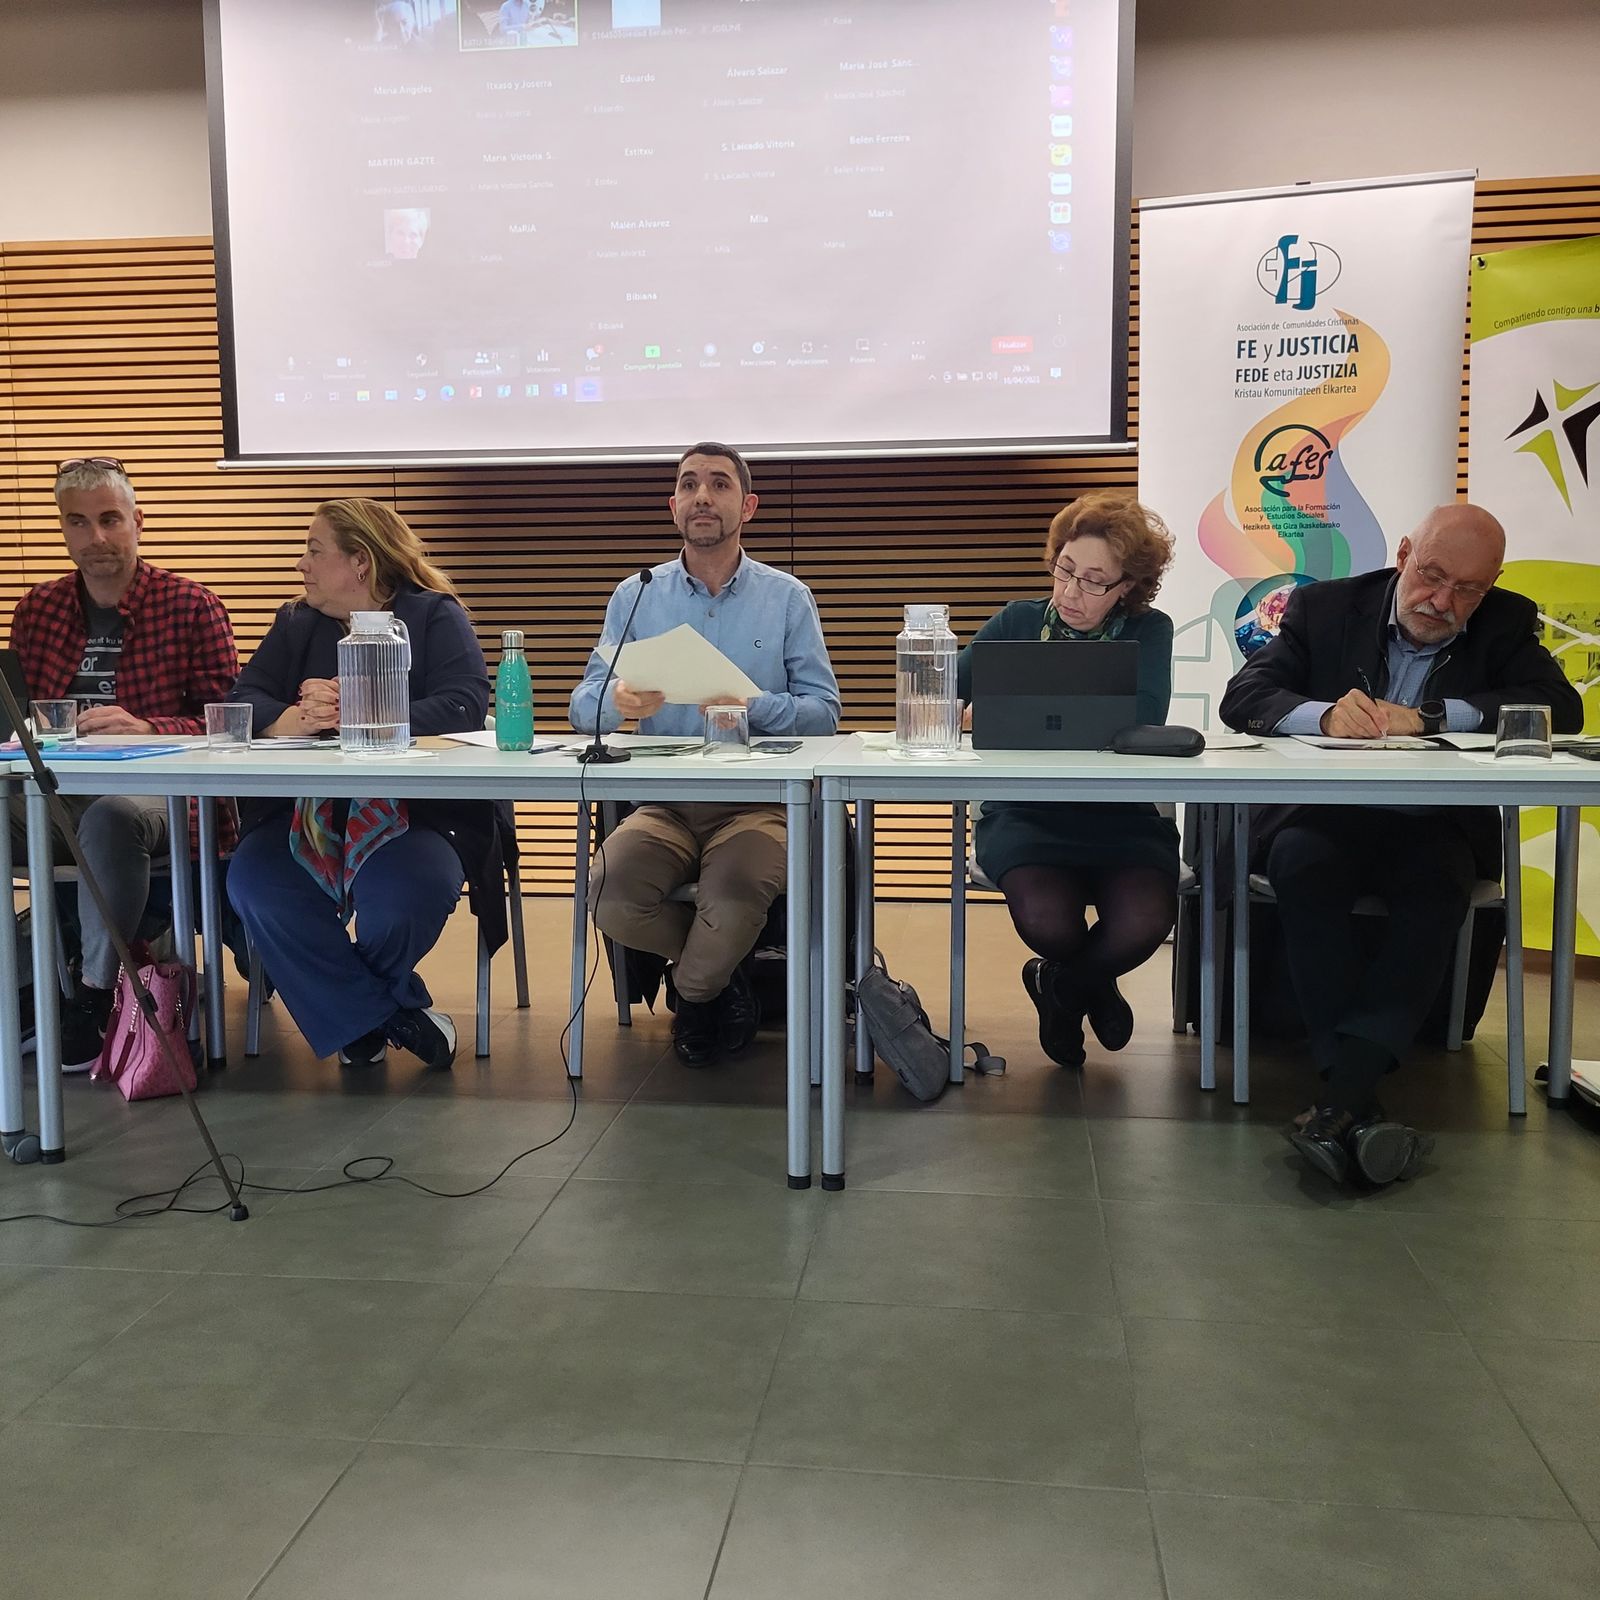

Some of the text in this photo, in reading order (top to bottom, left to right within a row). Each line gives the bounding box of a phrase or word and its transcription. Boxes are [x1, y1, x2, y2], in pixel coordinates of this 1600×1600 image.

[520, 79, 553, 89] Joserra
[619, 73, 656, 84] Eduardo
[766, 138, 796, 149] Vitoria
[875, 134, 911, 144] Ferreira
[1494, 308, 1546, 330] Compartiendo
[1547, 305, 1576, 316] contigo
[1577, 305, 1592, 314] una
[1236, 317, 1360, 332] Asociación de Comunidades Cristianas
[1236, 334, 1360, 363] FE y JUSTICIA
[1235, 362, 1359, 383] FEDE eta JUSTIZIA
[1234, 383, 1357, 399] Kristau Komunitateen Elkartea
[1265, 444, 1334, 484] afes
[1244, 503, 1341, 514] Asociación para la Formación
[1266, 512, 1295, 520] Estudios
[1296, 511, 1325, 519] Sociales
[1242, 523, 1270, 531] Heziketa
[1283, 522, 1298, 530] Giza
[754, 639, 762, 649] C
